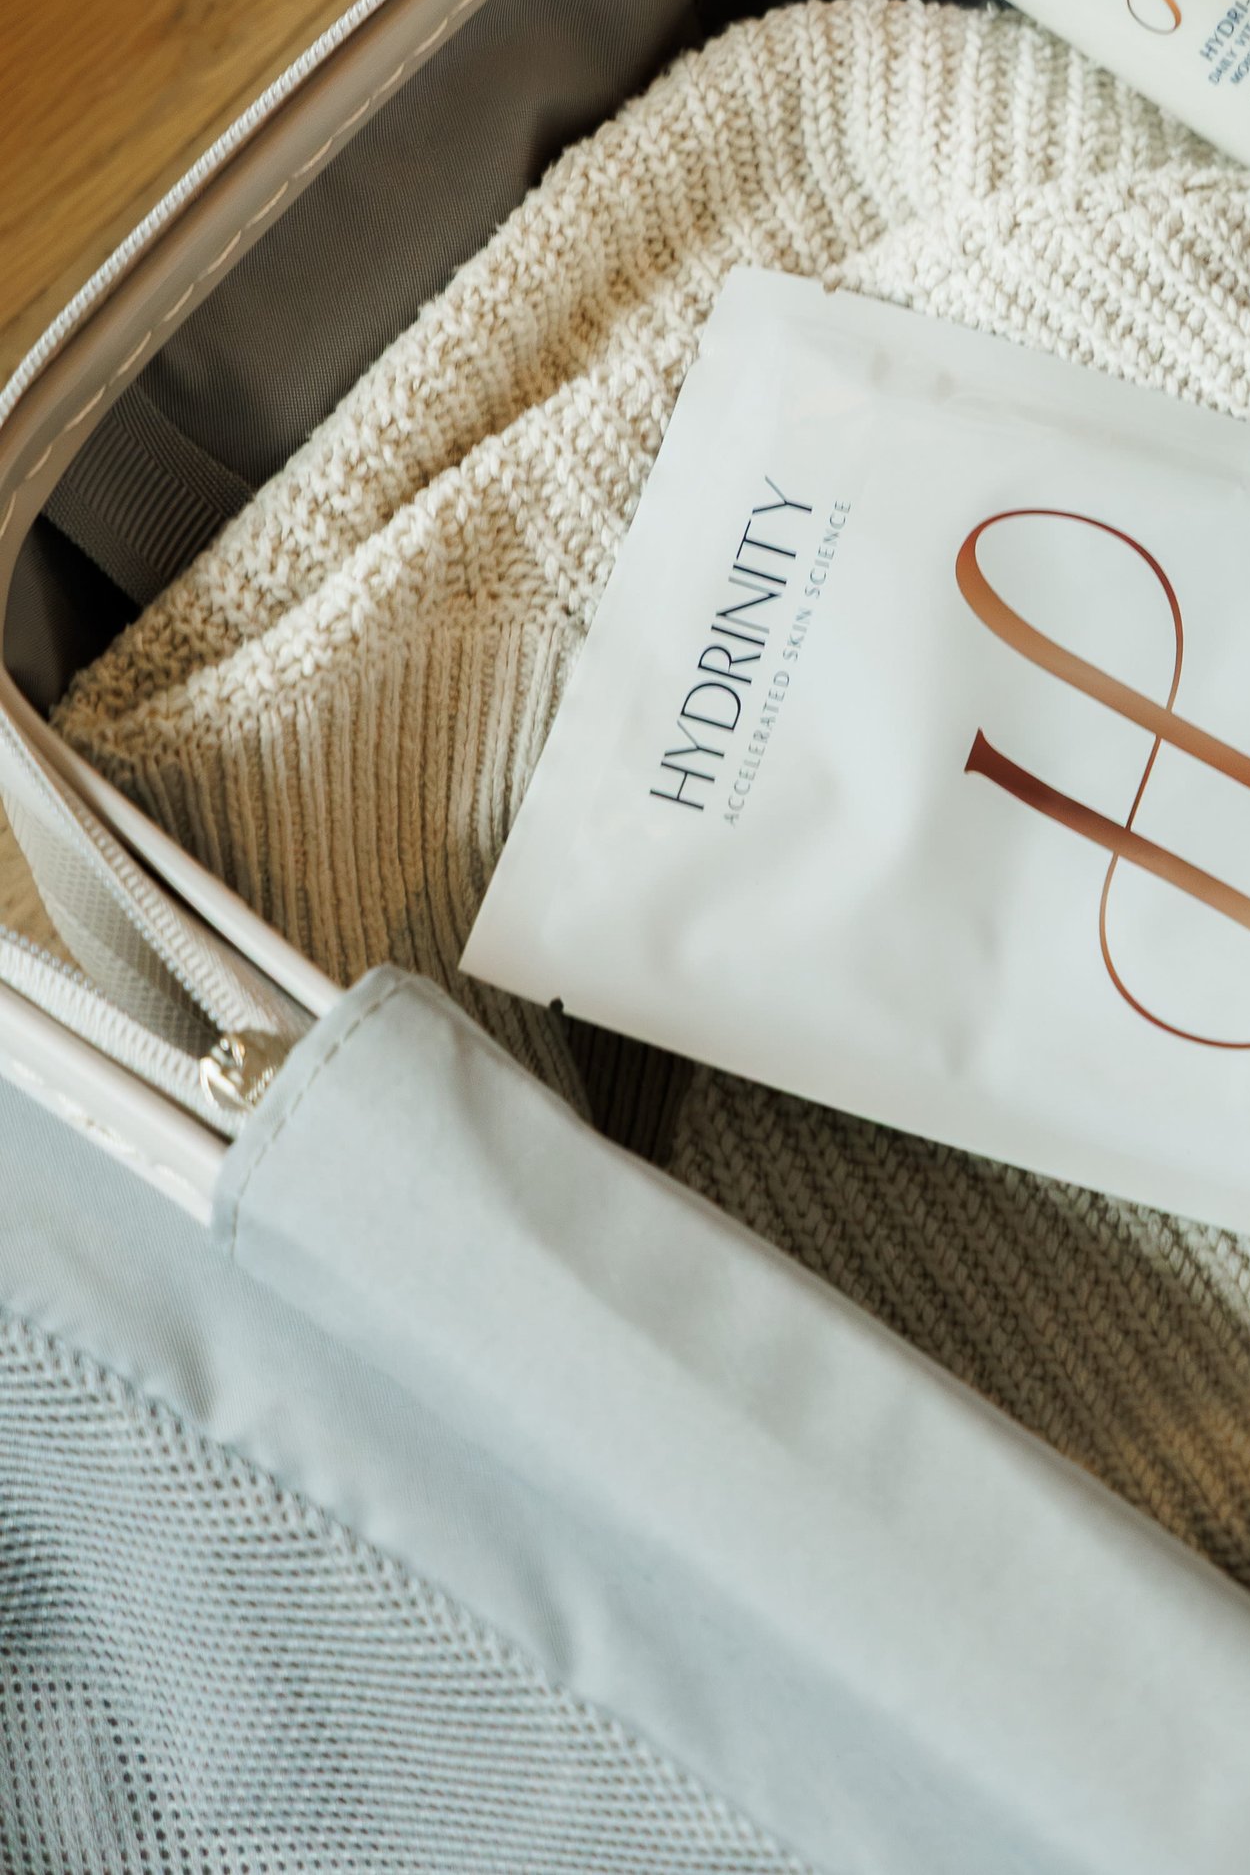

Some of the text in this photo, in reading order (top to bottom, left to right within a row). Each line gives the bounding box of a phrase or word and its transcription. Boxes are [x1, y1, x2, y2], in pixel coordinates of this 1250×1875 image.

[1207, 47, 1238, 86] DAILY
[649, 476, 813, 812] HYDRINITY
[723, 500, 852, 827] ACCELERATED SKIN SCIENCE
